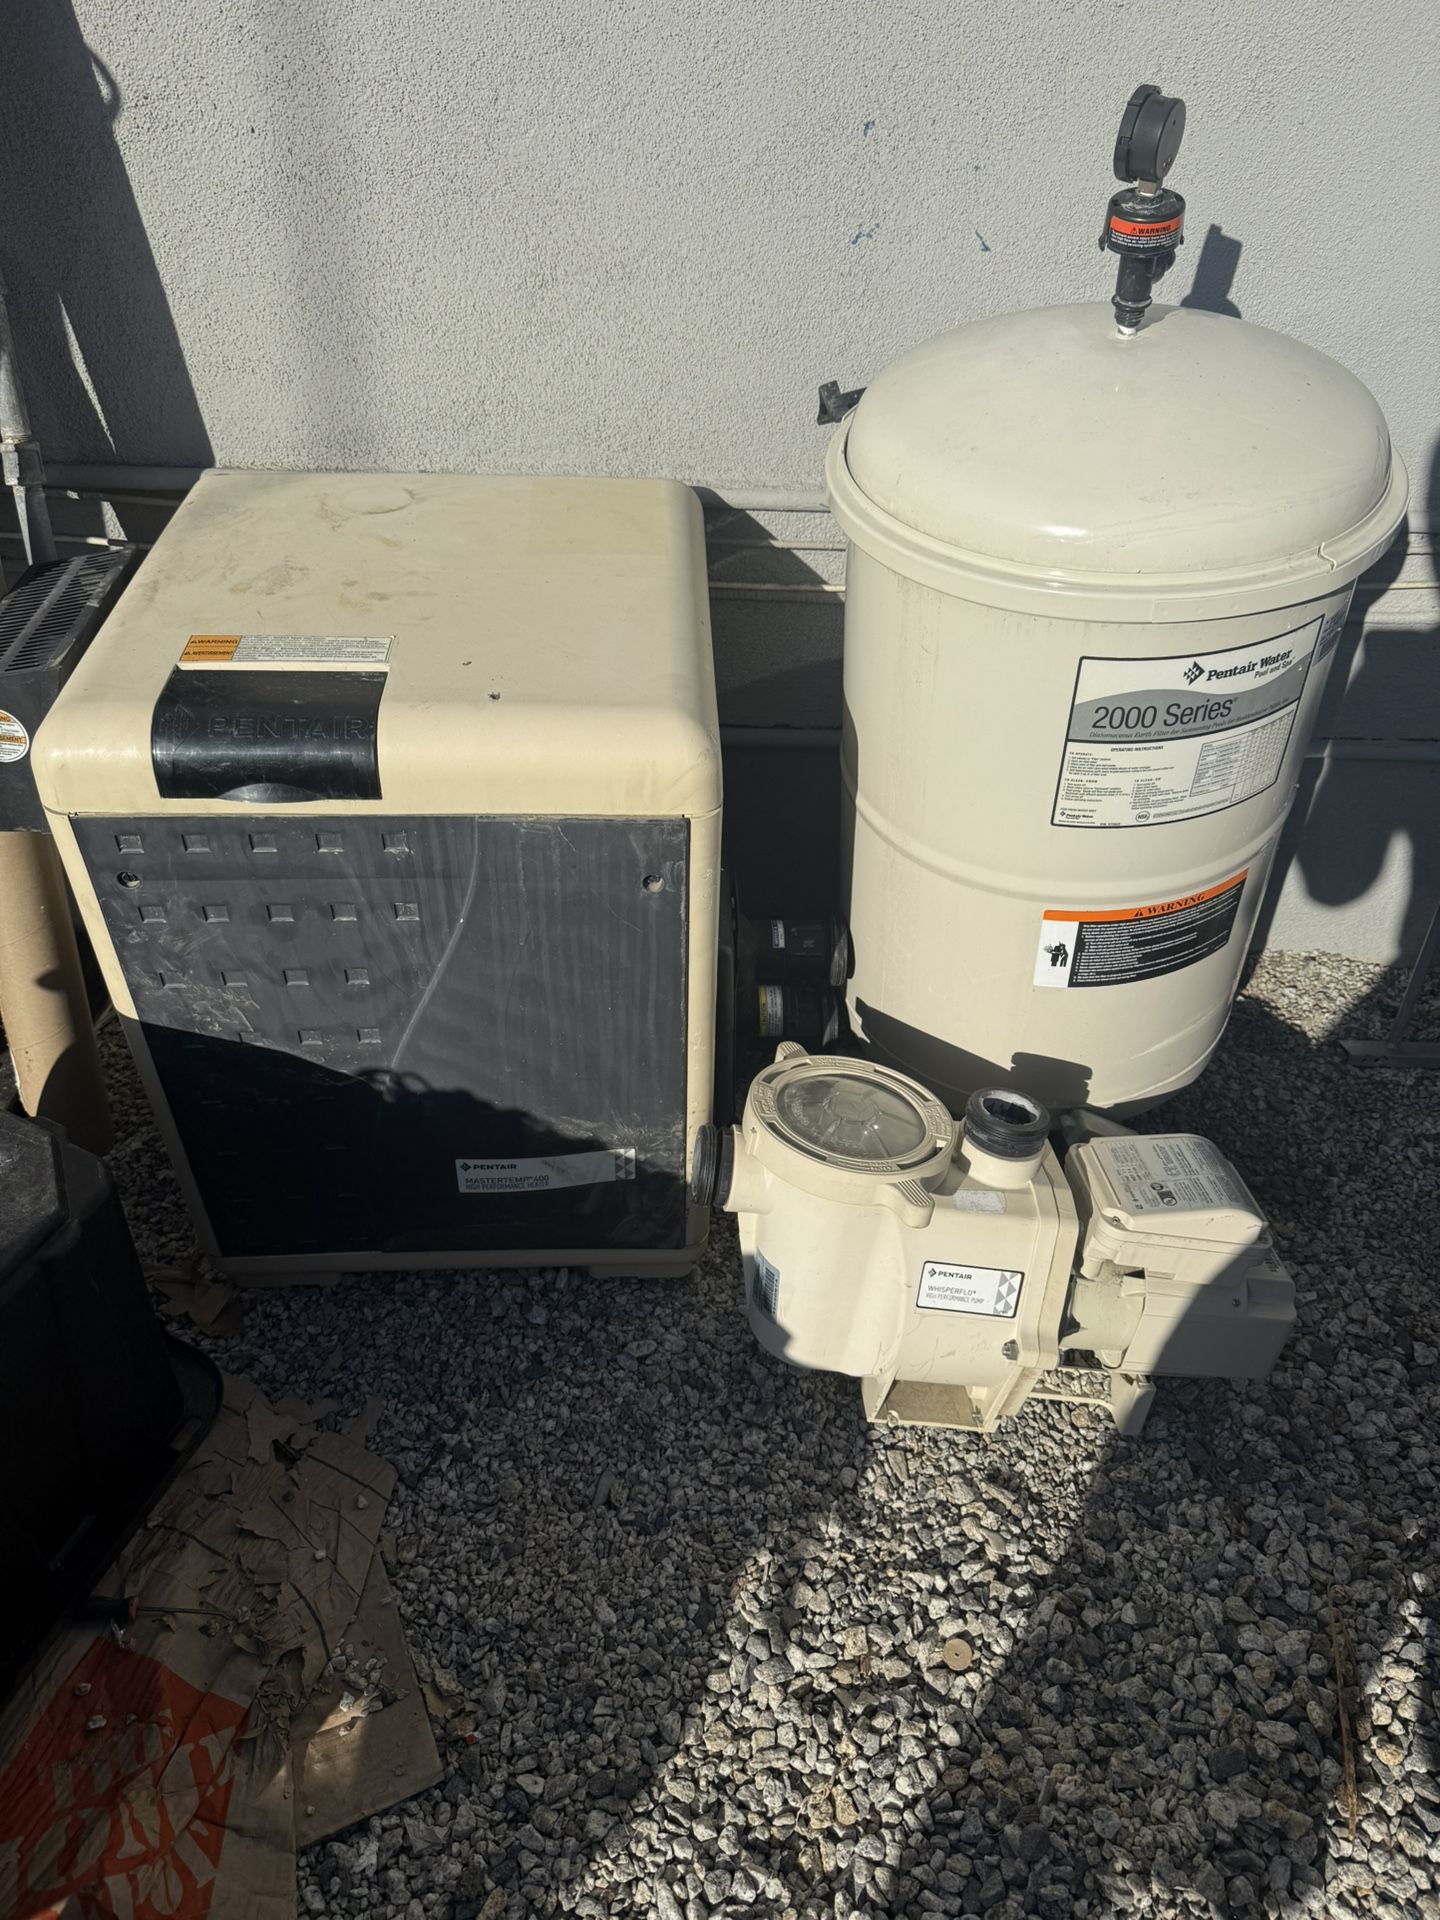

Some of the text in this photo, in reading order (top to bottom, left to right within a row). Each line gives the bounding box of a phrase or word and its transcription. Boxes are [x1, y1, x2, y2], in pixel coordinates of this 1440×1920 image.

[1138, 225, 1171, 235] WARNING
[1206, 649, 1293, 681] Pentair Water
[207, 715, 369, 740] PENTAIR
[1091, 705, 1158, 729] 2000
[1147, 892, 1205, 915] WARNING
[938, 1270, 972, 1280] PENTAIR
